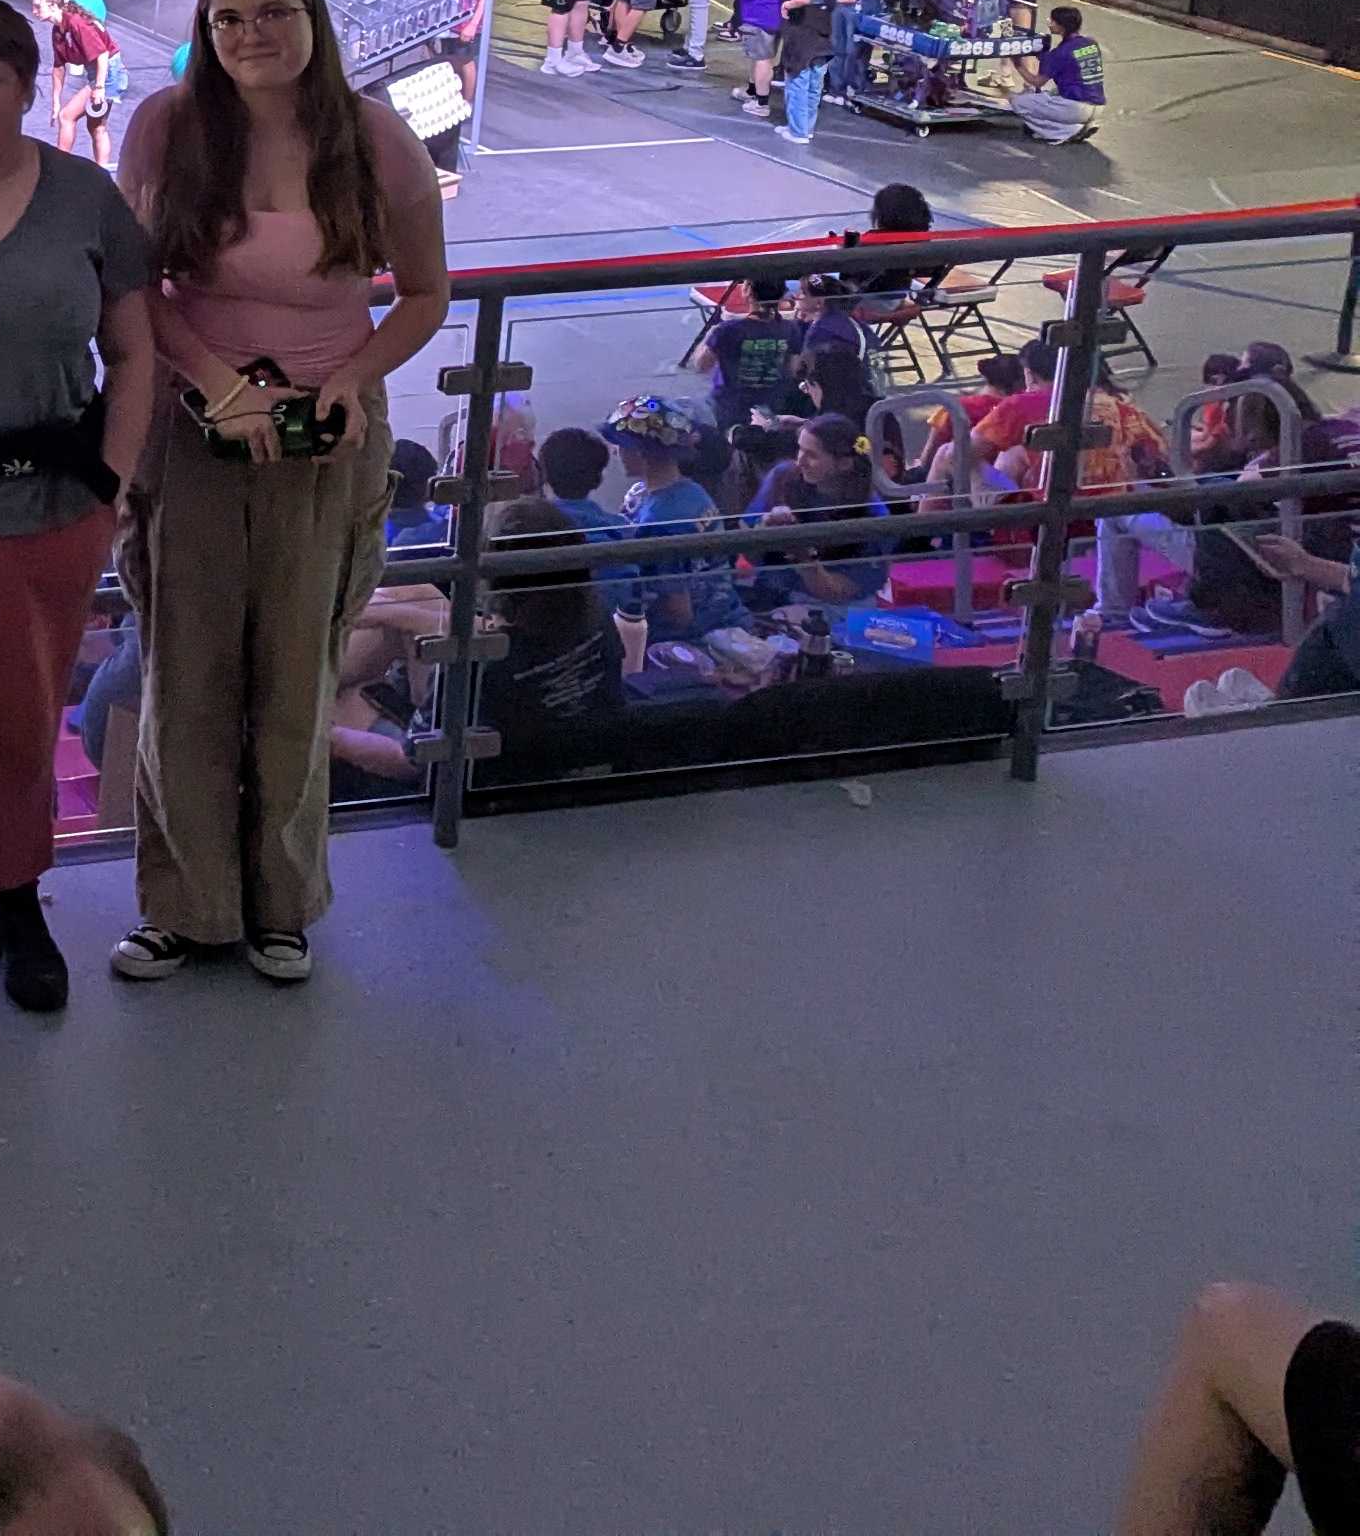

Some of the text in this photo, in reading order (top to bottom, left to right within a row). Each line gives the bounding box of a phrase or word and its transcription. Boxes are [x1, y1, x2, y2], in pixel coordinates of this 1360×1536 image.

[879, 24, 915, 47] 2265
[949, 40, 995, 57] 2265
[999, 38, 1044, 57] 2265
